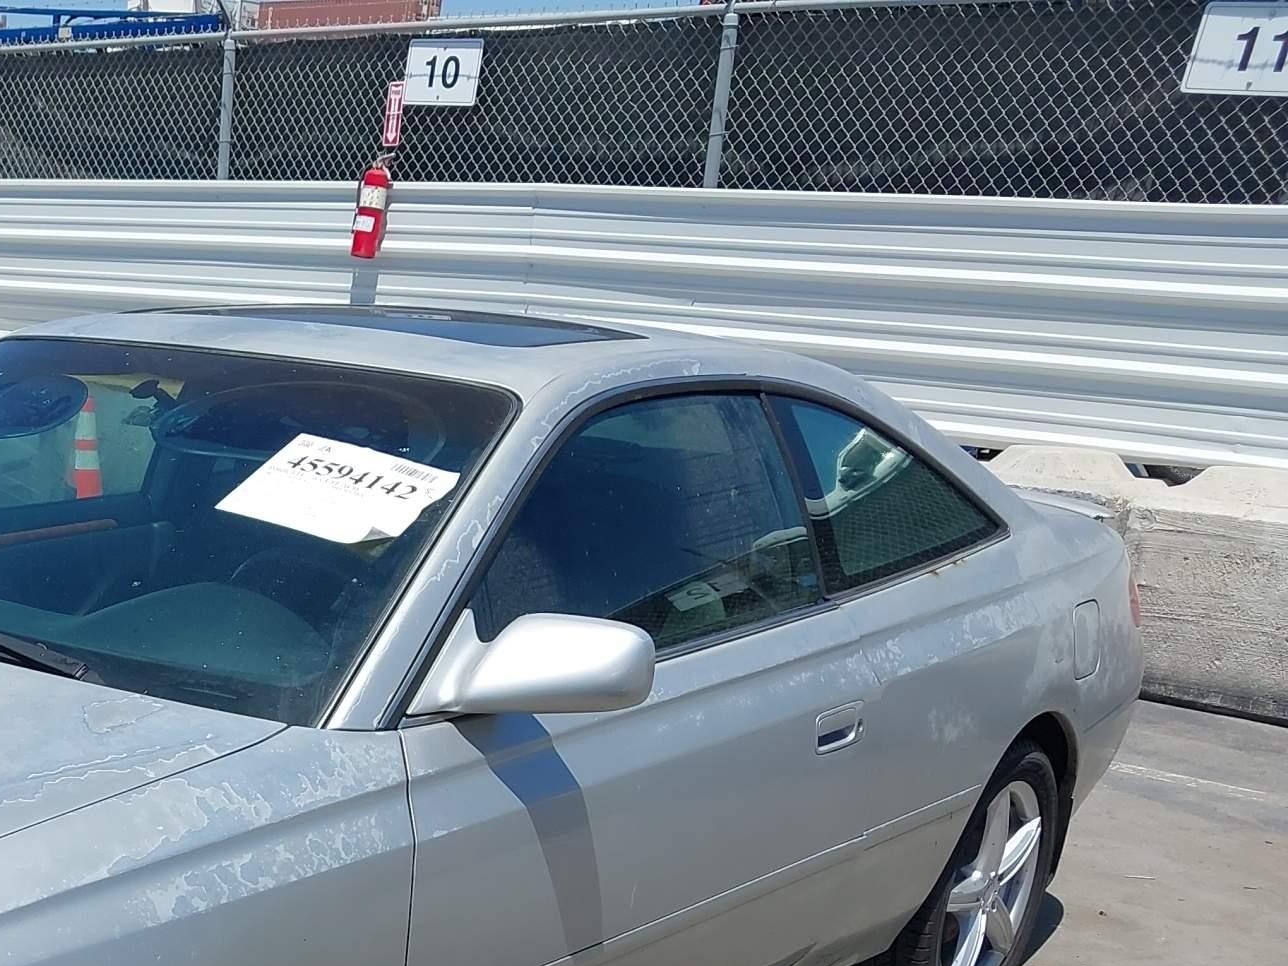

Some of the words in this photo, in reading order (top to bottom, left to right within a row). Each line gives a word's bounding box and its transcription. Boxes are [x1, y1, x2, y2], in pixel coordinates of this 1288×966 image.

[1237, 26, 1288, 72] 11
[425, 55, 461, 89] 10
[287, 456, 418, 499] 45594142
